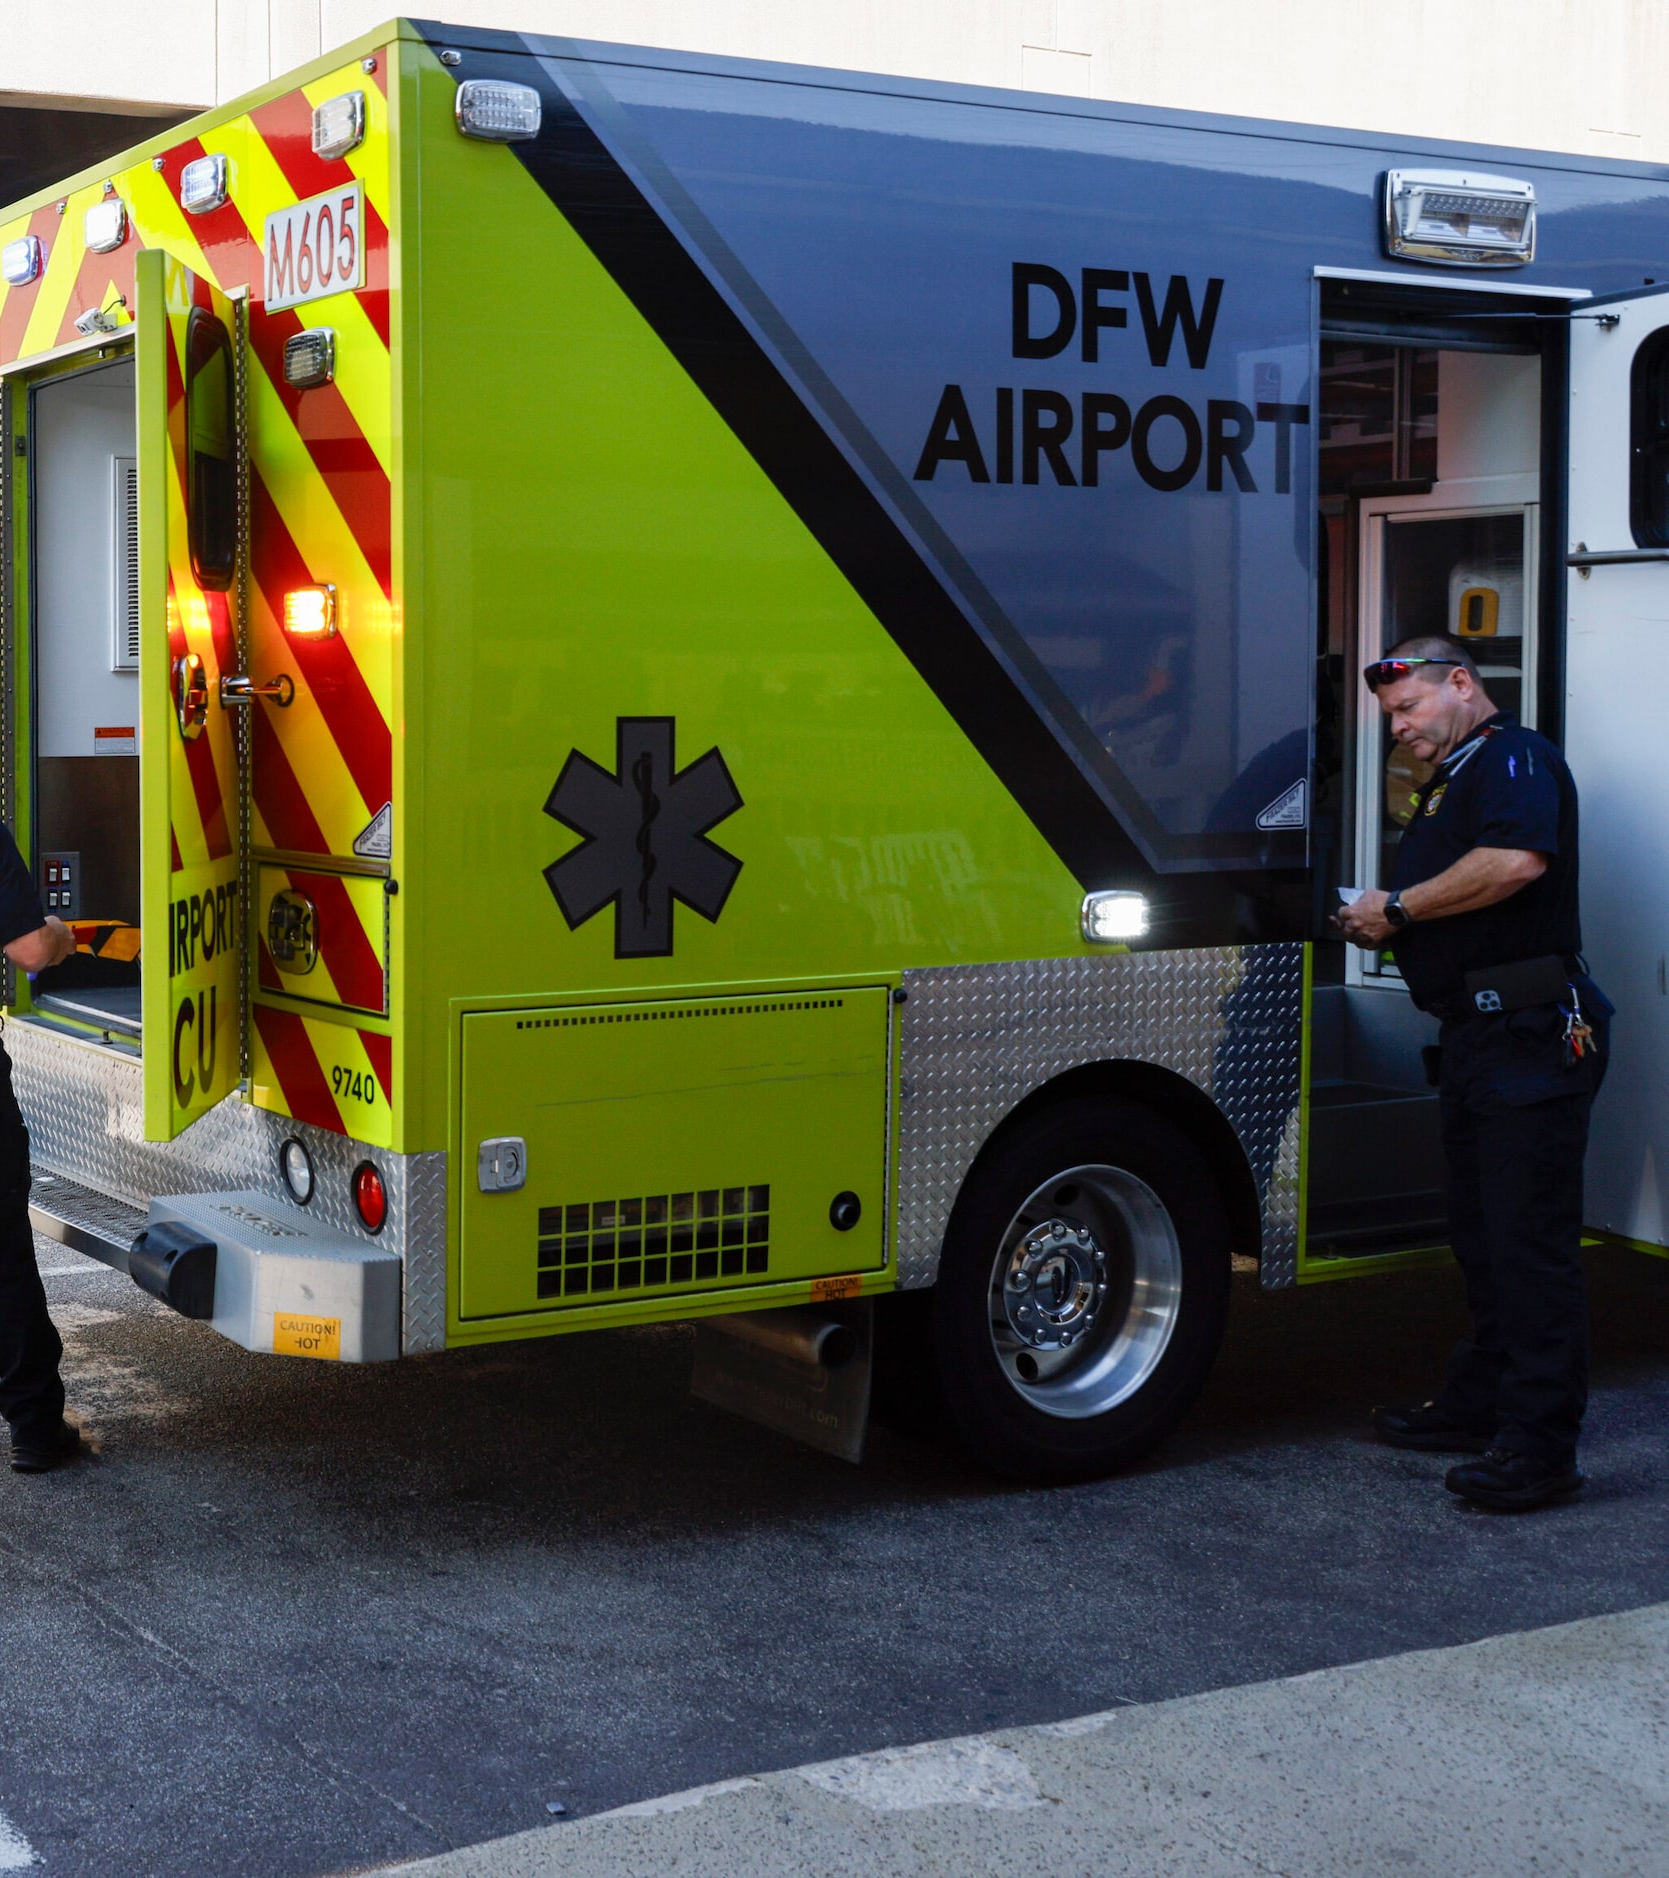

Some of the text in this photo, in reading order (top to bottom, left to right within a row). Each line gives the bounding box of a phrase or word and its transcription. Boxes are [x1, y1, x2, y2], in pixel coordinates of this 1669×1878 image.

[268, 195, 354, 302] M605
[1012, 262, 1224, 369] DFW
[913, 384, 1309, 494] AIRPORT
[174, 985, 217, 1110] CU
[332, 1065, 375, 1105] 9740
[815, 1277, 859, 1290] CAUTION!
[825, 1288, 845, 1300] HOT
[280, 1320, 336, 1336] CAUTION!
